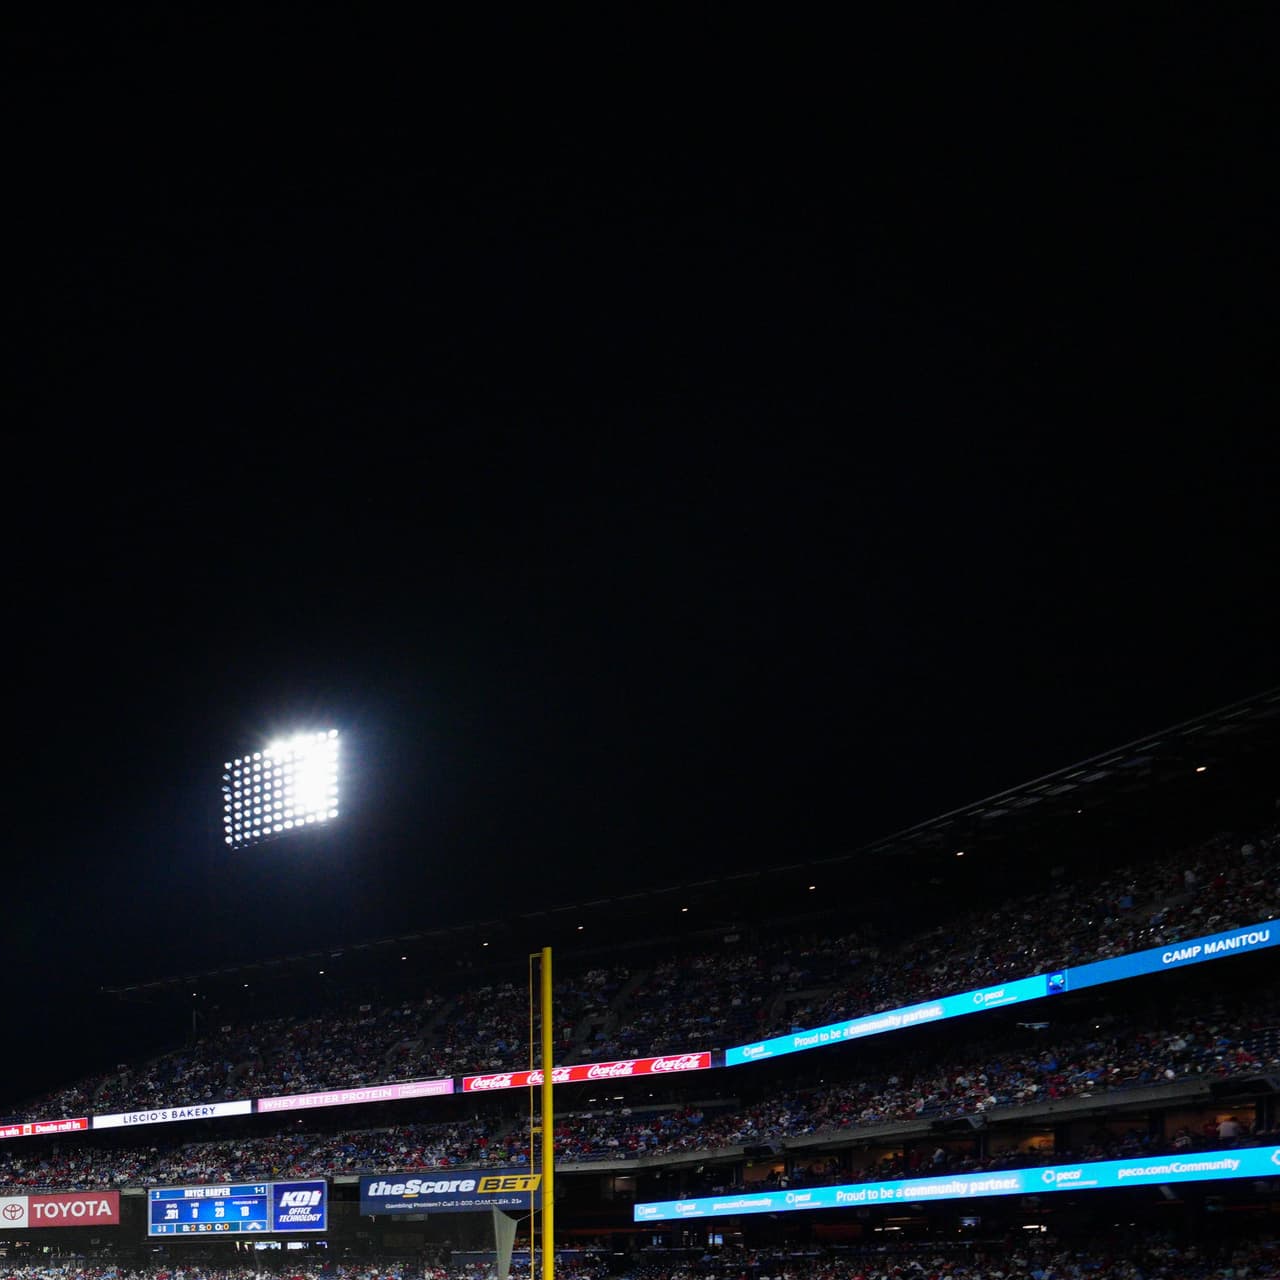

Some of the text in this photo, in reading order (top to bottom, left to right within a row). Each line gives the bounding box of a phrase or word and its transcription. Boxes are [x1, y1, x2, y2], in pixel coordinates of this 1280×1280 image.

[1162, 930, 1270, 964] CAMP MANITOU
[794, 1032, 818, 1047] Proud
[820, 1030, 829, 1041] to
[830, 1028, 841, 1038] be
[850, 1014, 902, 1036] community
[587, 1061, 635, 1079] Coca-Cola
[650, 1053, 701, 1072] Coca-Cola
[470, 1073, 511, 1090] Coca-Cola
[263, 1098, 297, 1110] WHEY
[299, 1093, 339, 1106] BETTER
[342, 1089, 392, 1102] PROTEIN
[123, 1105, 216, 1125] LISCIO'S BAKERY
[5, 1126, 20, 1137] win
[57, 1121, 71, 1131] roll
[72, 1120, 81, 1129] in
[1056, 1169, 1082, 1183] peco
[1117, 1159, 1240, 1180] peco.com/Community
[184, 1187, 231, 1198] BRYCE HARPER
[254, 1186, 265, 1194] 1-1
[368, 1176, 537, 1197] theScore BET
[836, 1189, 865, 1202] Proud
[867, 1188, 879, 1199] to
[880, 1185, 894, 1199] be
[904, 1180, 969, 1199] community
[970, 1177, 1019, 1194] partner.
[280, 1190, 322, 1207] KDI
[33, 1199, 113, 1219] TOYOTA
[279, 1213, 322, 1223] TECHNOLOGY
[289, 1207, 310, 1215] OFFICE
